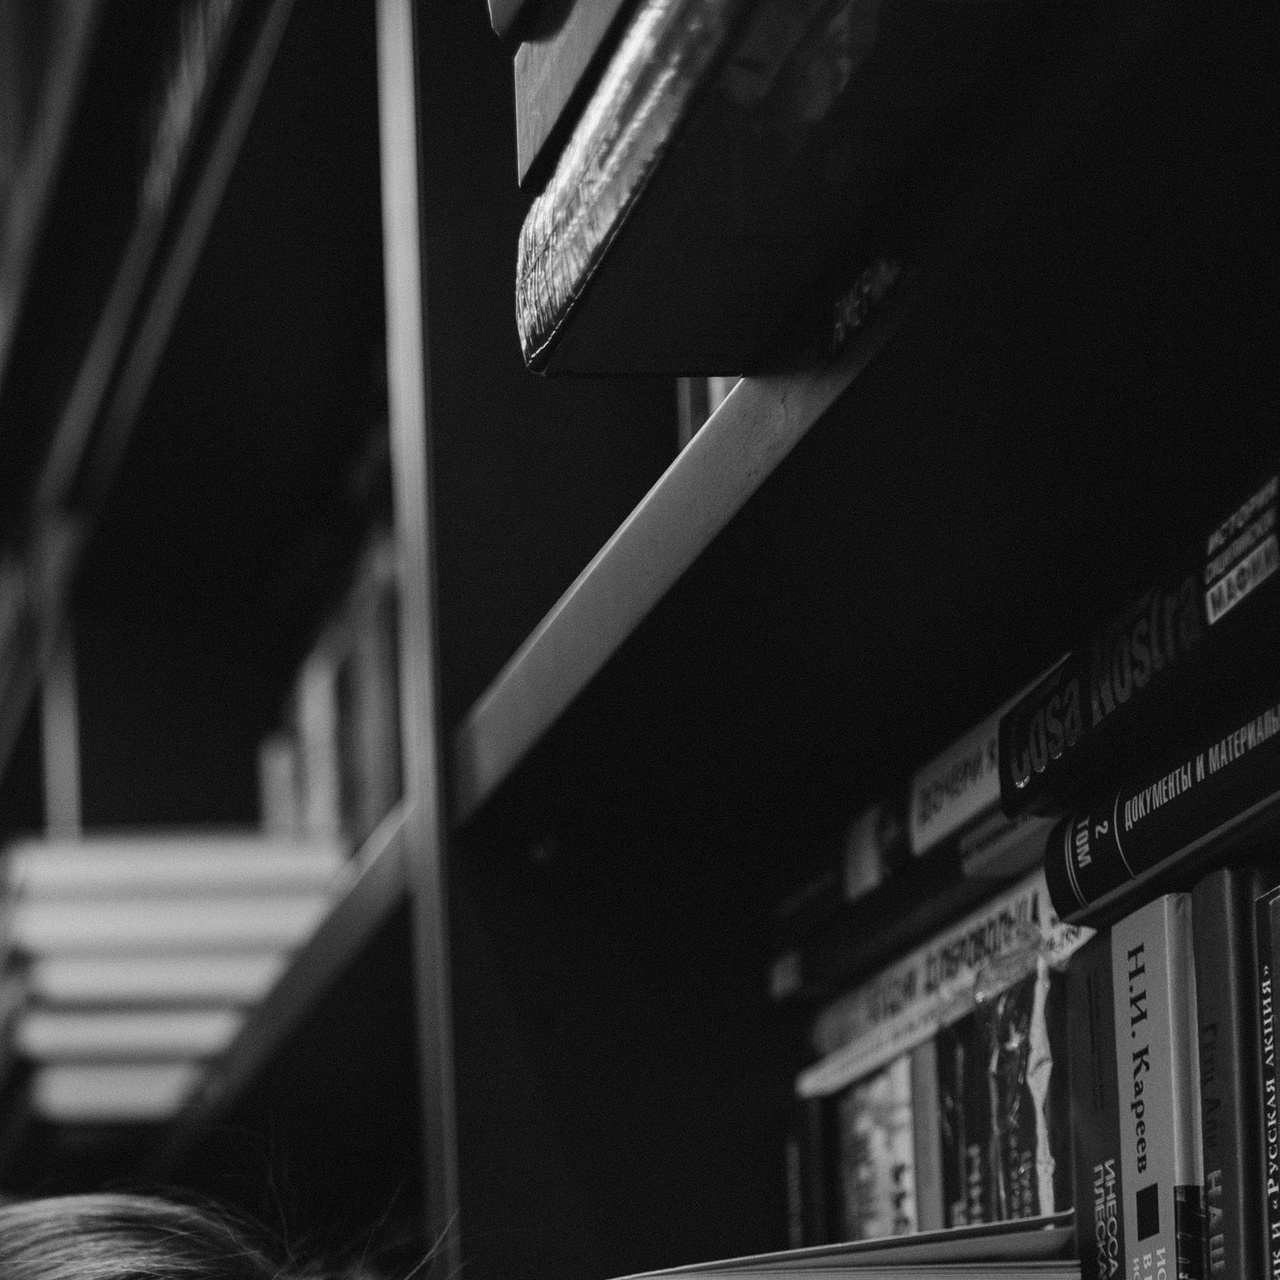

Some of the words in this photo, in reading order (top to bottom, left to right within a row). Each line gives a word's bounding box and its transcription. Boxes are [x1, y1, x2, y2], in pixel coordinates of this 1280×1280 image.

[1094, 819, 1110, 840] 2
[1123, 760, 1193, 833] ДОКУМЕНТЫ
[1195, 752, 1206, 784] И
[1131, 1044, 1151, 1175] Кареев
[1104, 1160, 1120, 1278] ИНЕССА
[1143, 1253, 1154, 1270] В
